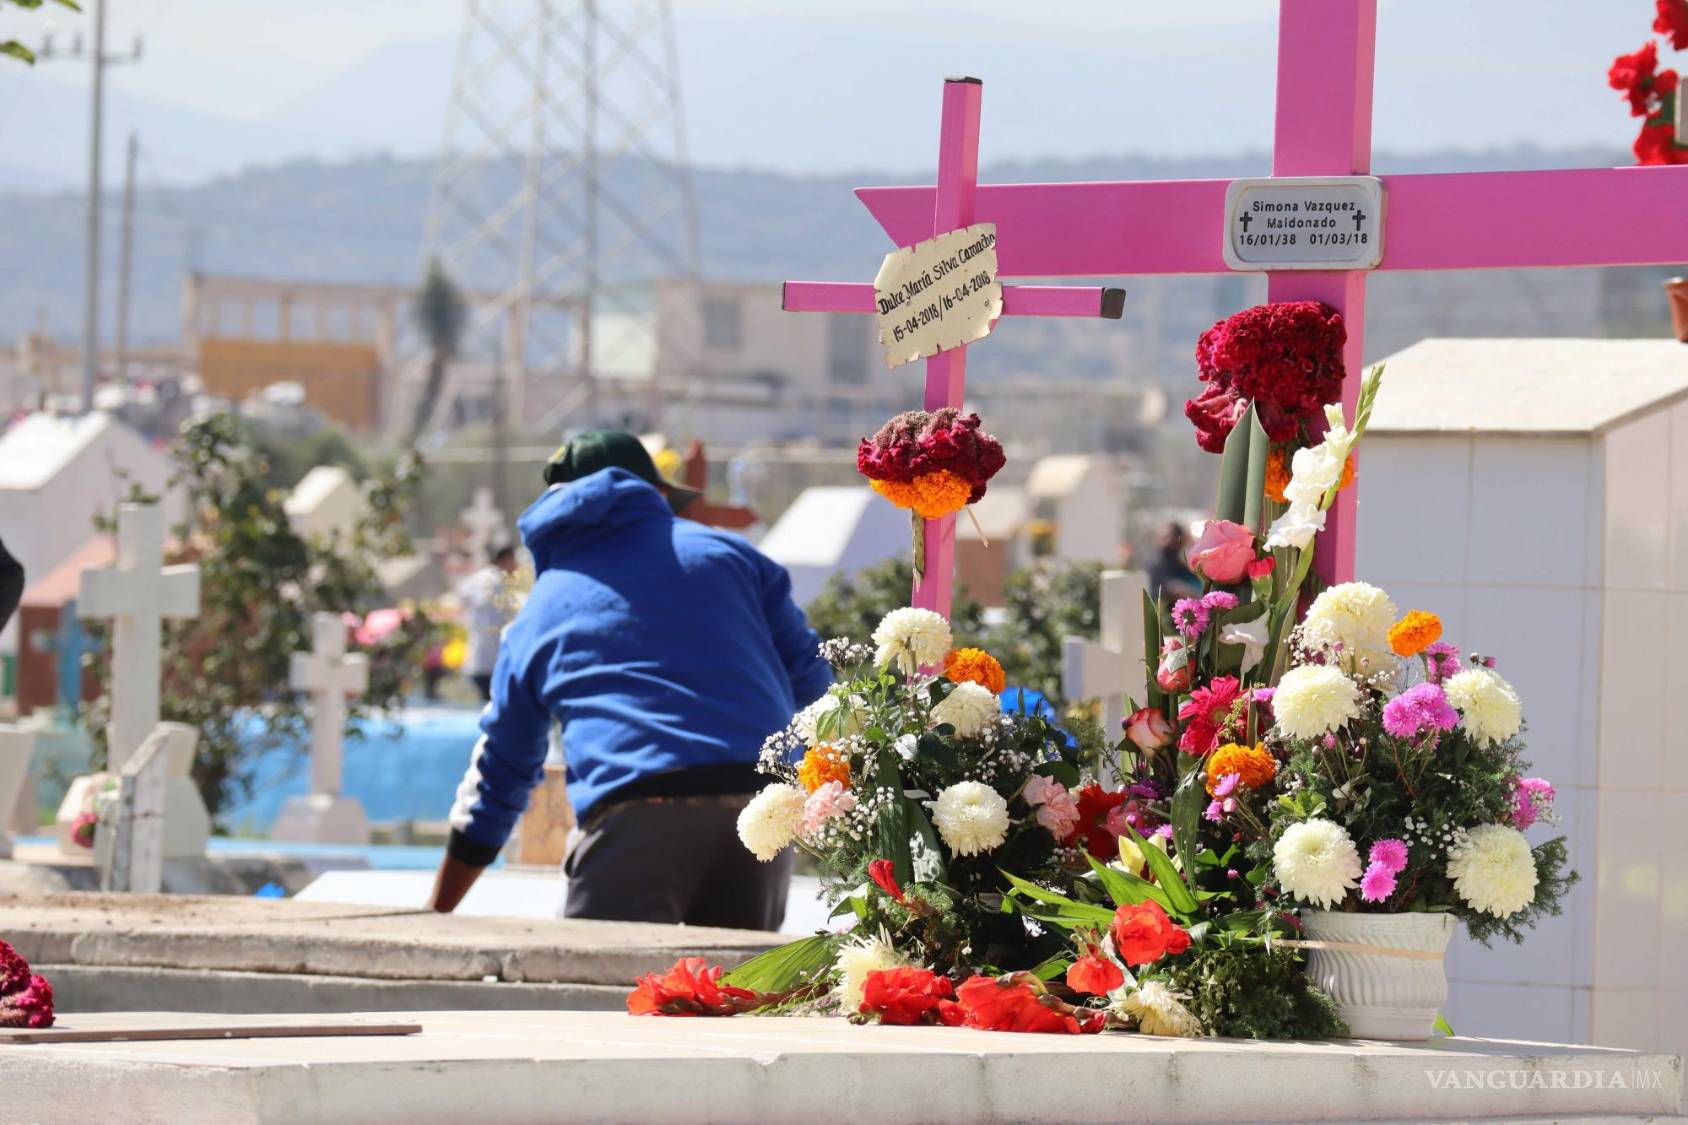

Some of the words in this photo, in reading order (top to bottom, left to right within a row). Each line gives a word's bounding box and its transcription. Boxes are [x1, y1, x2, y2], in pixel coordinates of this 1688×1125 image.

[1252, 201, 1298, 212] Simona
[1304, 201, 1355, 213] Vazquez
[1267, 217, 1336, 228] Maldonado
[1240, 234, 1296, 246] 16/01/38
[1310, 233, 1368, 245] 01/03/18
[878, 291, 905, 315] Dulce
[902, 270, 933, 300] María
[933, 260, 959, 280] Silva
[958, 233, 995, 264] Camacho
